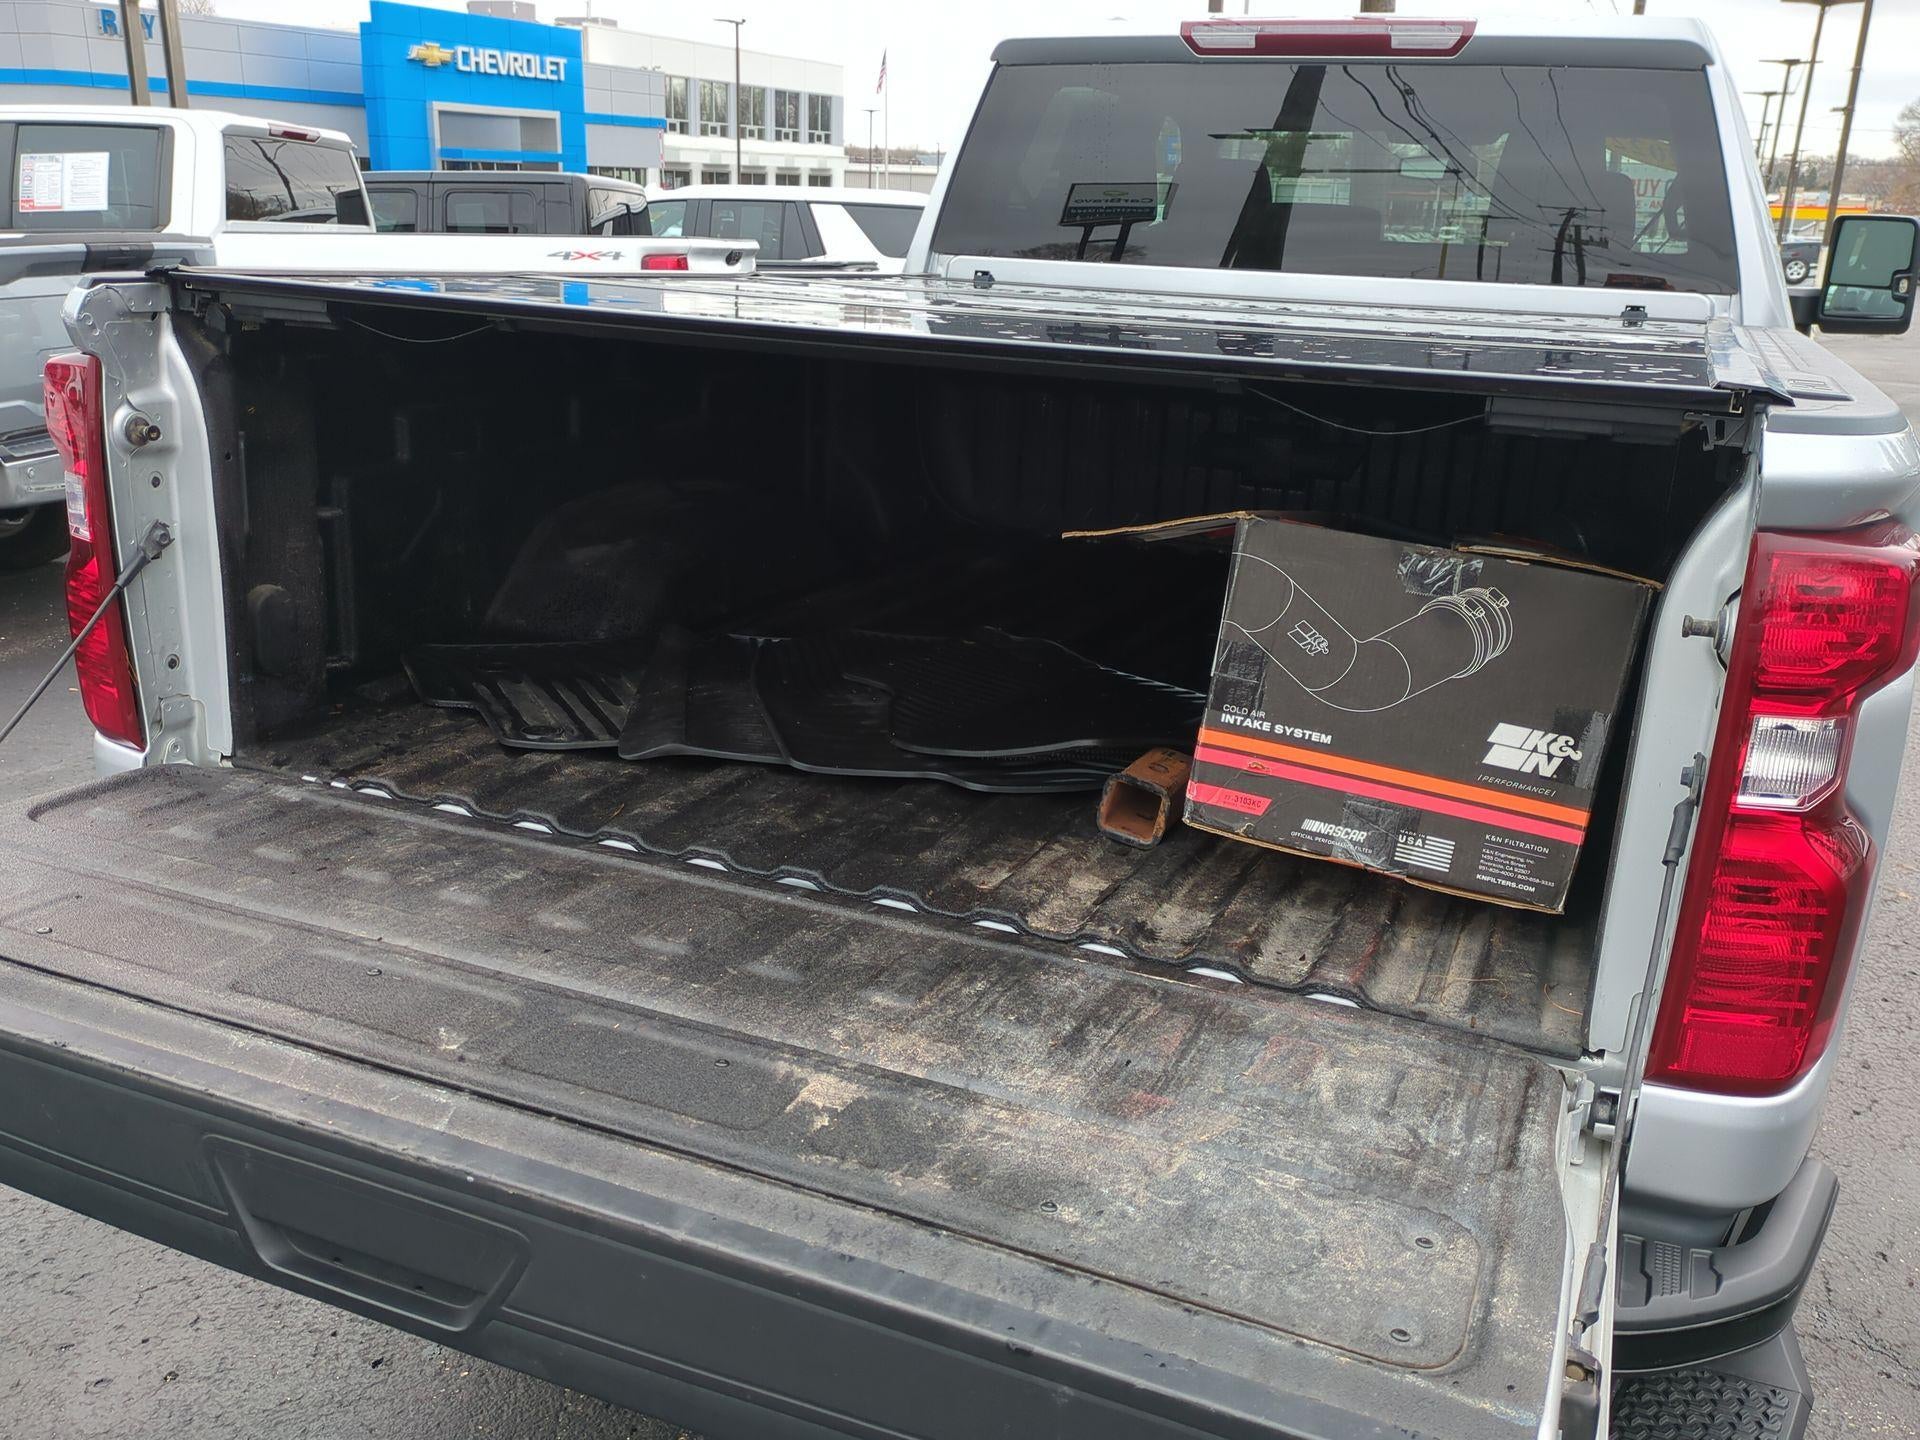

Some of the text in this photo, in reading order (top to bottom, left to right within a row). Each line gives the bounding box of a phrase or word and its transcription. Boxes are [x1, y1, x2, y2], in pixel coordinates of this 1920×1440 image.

[100, 9, 155, 38] RY
[455, 46, 567, 81] CHEVROLET
[1223, 704, 1266, 719] COLD AIR
[1221, 713, 1333, 744] INTAKE SYSTEM
[1290, 831, 1314, 841] OFFICIAL
[1315, 822, 1367, 843] NASCAR
[1398, 834, 1423, 847] USA
[1485, 834, 1550, 854] K&N FILTRATION
[1476, 873, 1536, 893] KNFILTERS.COM
